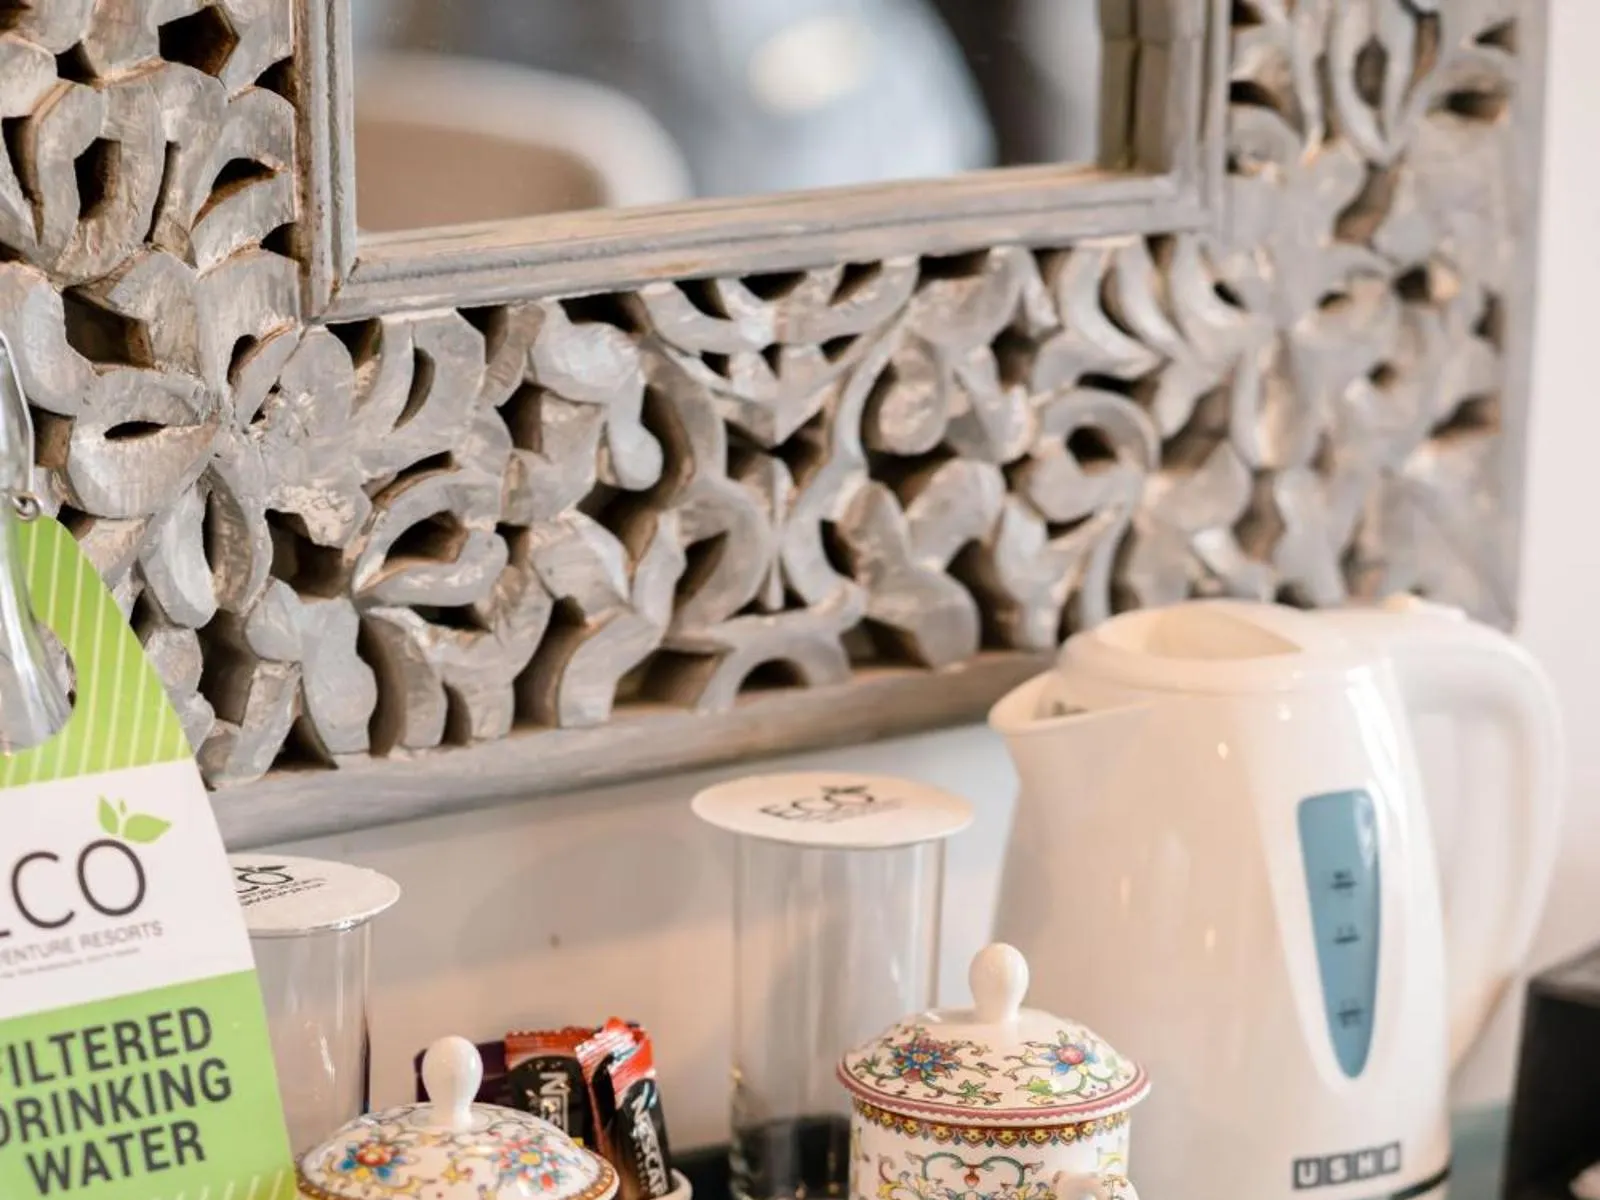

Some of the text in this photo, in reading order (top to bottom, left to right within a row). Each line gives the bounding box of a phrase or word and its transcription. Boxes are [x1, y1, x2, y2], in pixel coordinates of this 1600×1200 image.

[0, 839, 146, 939] CO
[0, 936, 75, 967] ENTURE
[80, 920, 164, 950] RESORTS
[0, 1006, 212, 1087] ILTERED
[25, 1120, 206, 1196] WATER
